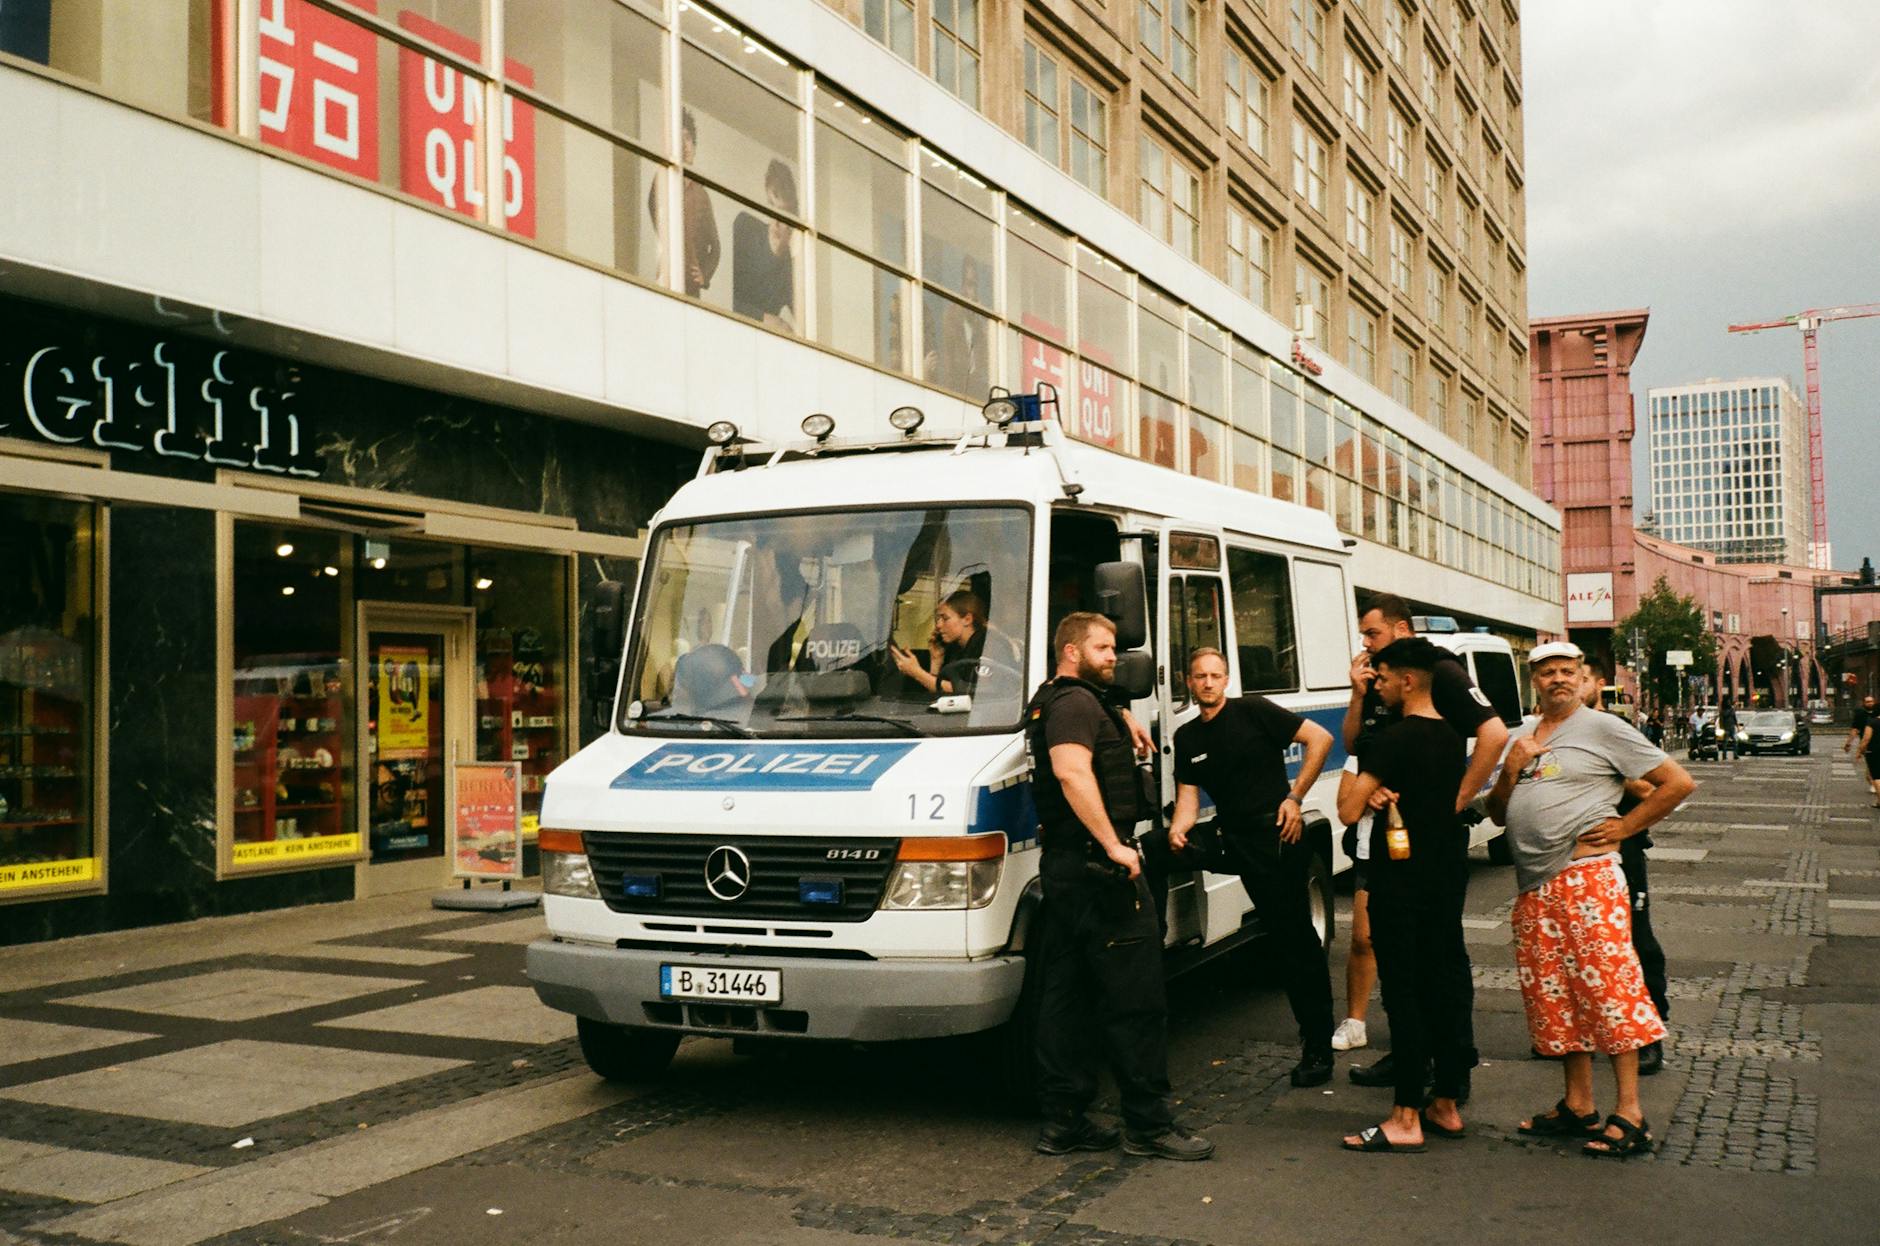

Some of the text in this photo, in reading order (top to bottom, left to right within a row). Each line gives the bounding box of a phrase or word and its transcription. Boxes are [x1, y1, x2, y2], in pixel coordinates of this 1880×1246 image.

[1082, 360, 1110, 398] UNI
[1082, 397, 1112, 439] QLO
[805, 639, 861, 659] POLIZEI
[644, 753, 881, 776] POLIZEI
[21, 864, 84, 880] ANSTEHEN!
[706, 972, 767, 996] 31446
